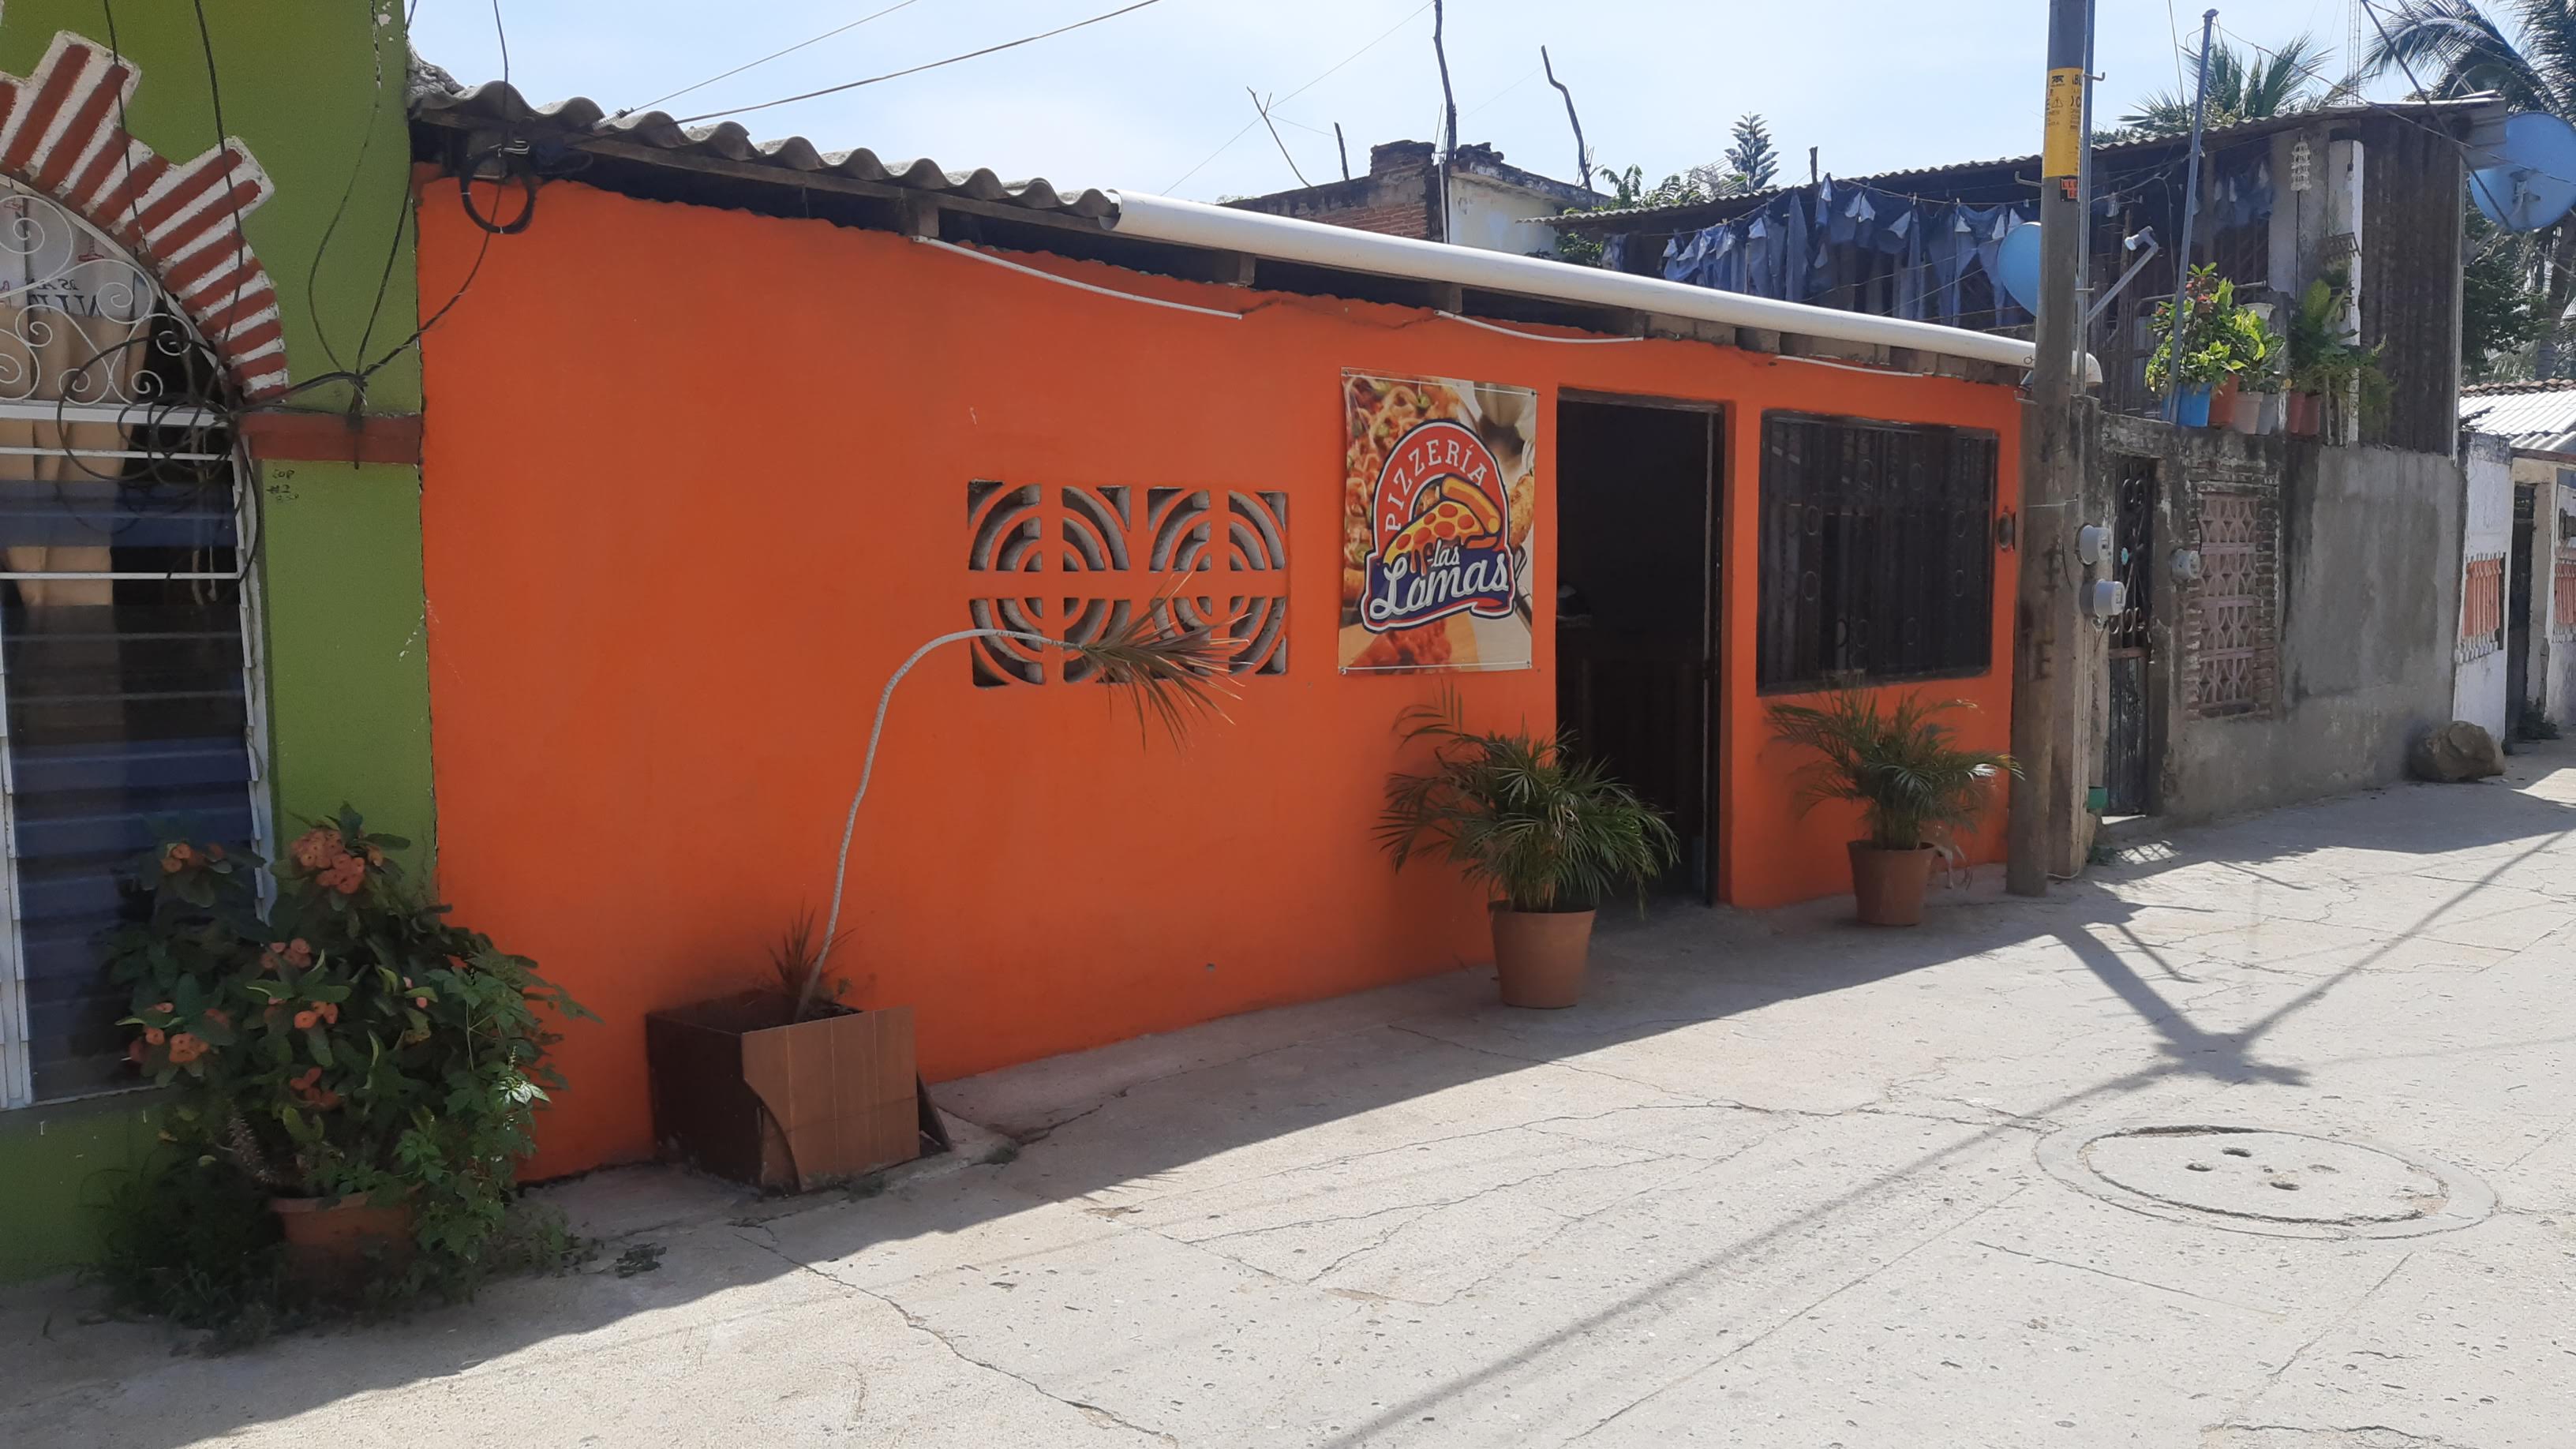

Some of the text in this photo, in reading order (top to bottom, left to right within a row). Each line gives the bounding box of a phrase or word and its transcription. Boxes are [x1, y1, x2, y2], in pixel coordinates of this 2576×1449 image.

[1385, 439, 1488, 533] PIZZERÍA
[1369, 553, 1509, 620] Lomas
[1428, 539, 1460, 567] las
